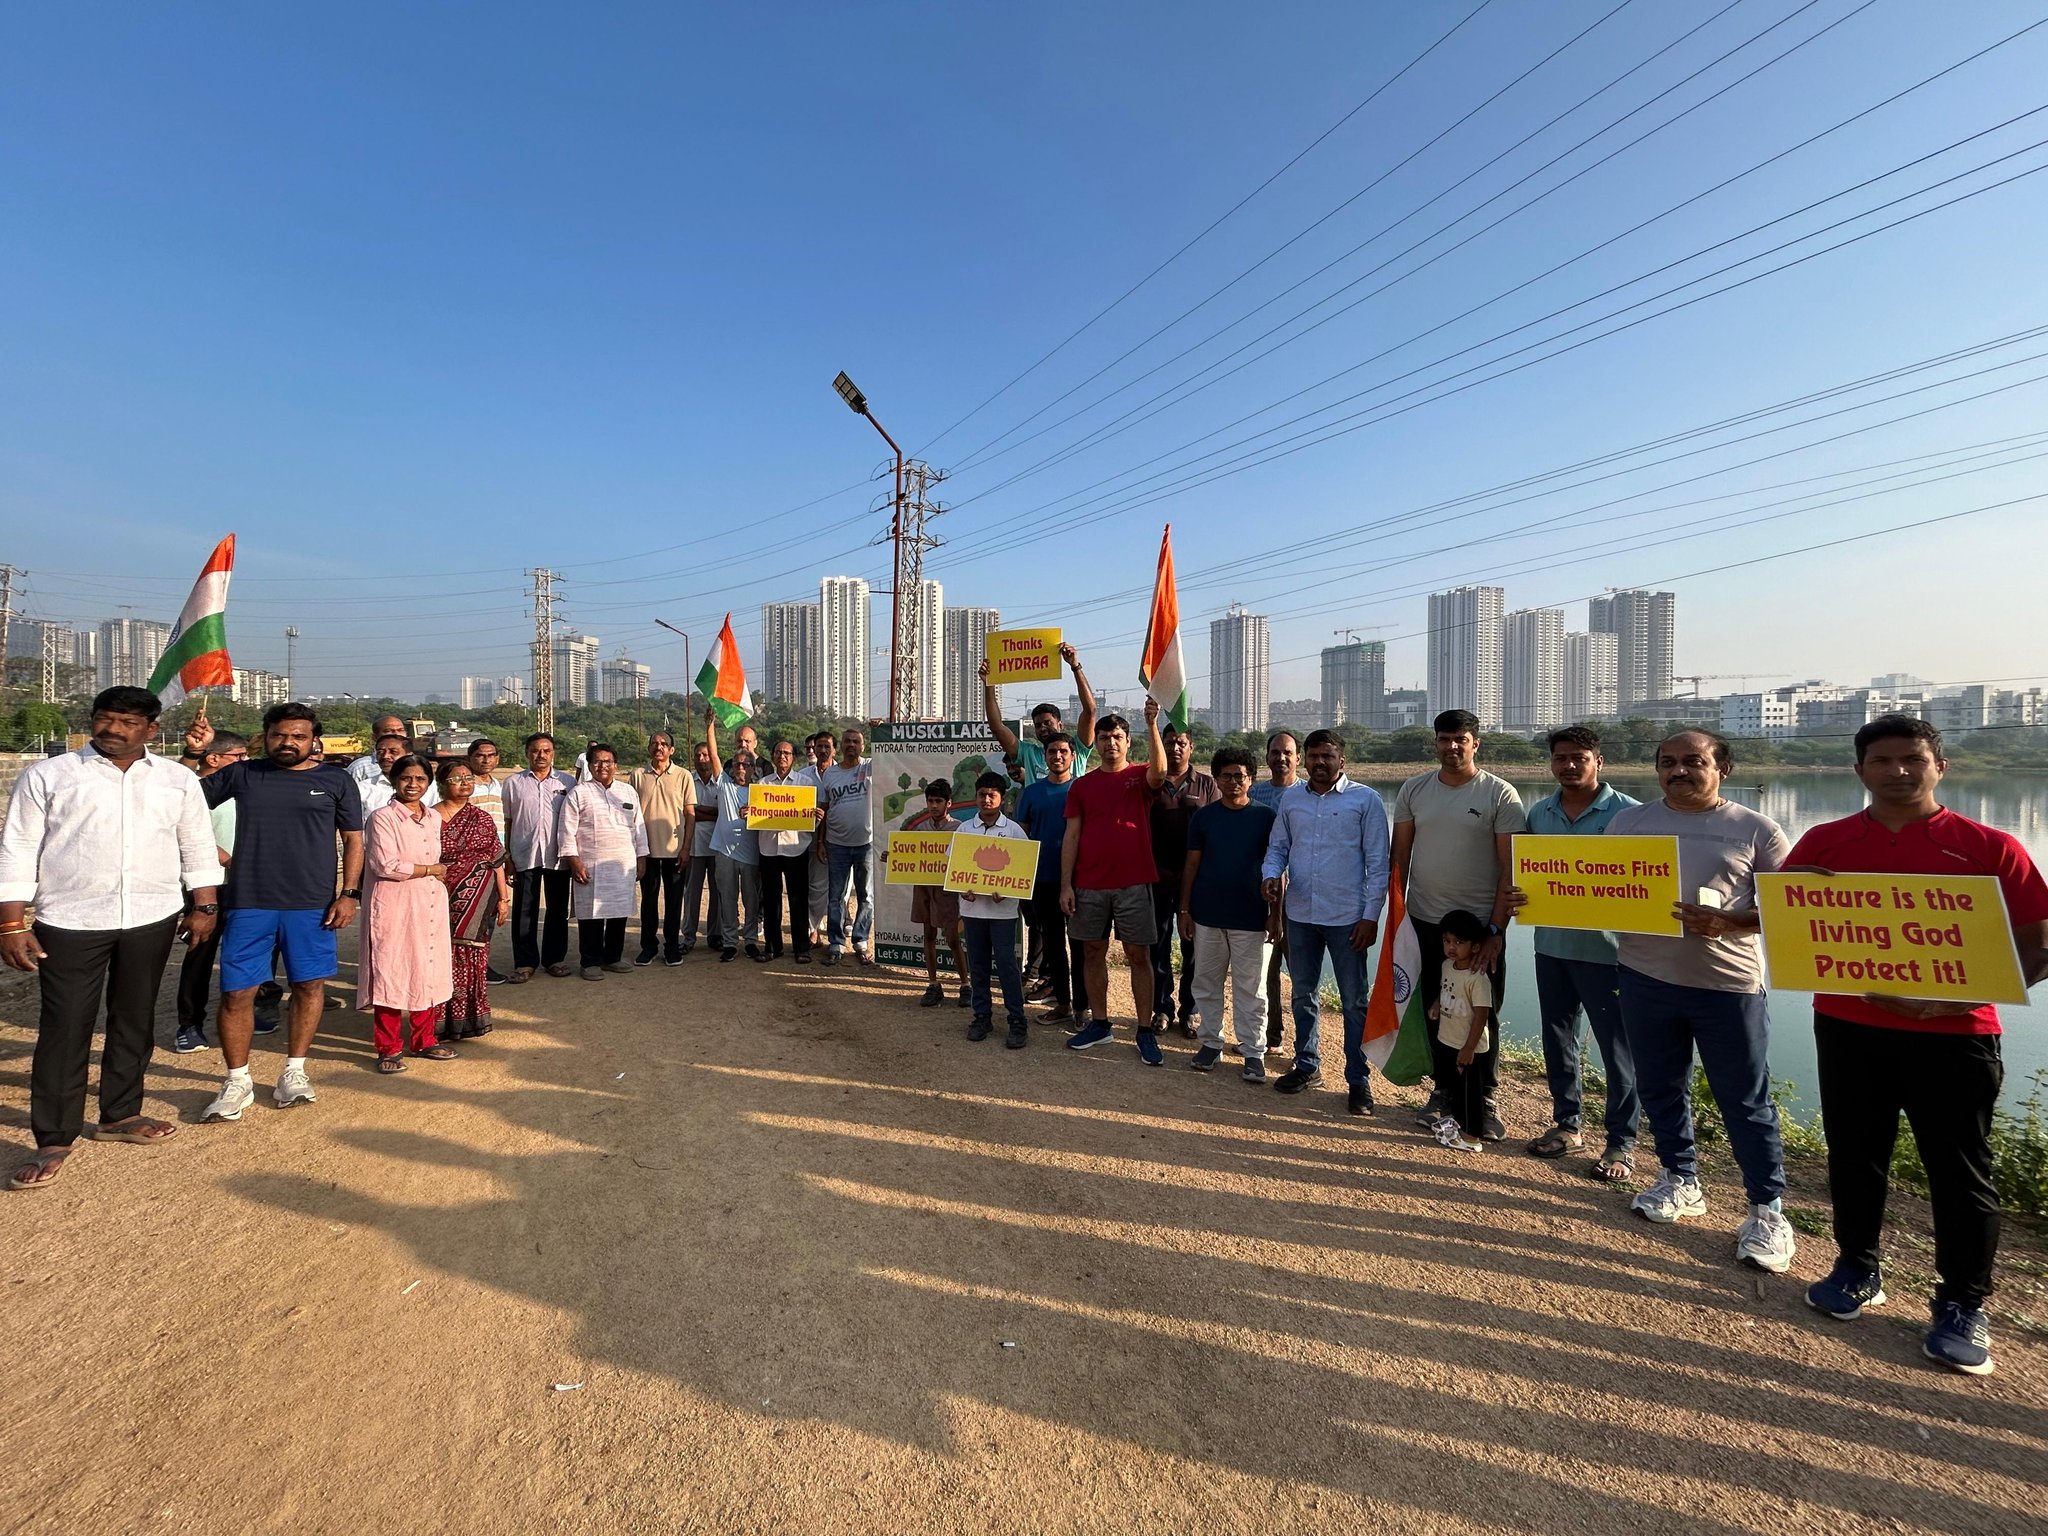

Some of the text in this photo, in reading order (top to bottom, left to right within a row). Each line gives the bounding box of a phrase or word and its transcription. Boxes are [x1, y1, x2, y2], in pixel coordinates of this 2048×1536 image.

[1002, 637, 1043, 652] Thanks
[998, 655, 1048, 673] HYDRAA
[892, 723, 993, 739] MUSKI LAKE
[874, 744, 903, 753] HYDRAA
[905, 743, 916, 752] for
[918, 743, 955, 754] Protecting
[956, 743, 987, 754] People's
[763, 792, 795, 803] Thanks
[831, 782, 867, 799] NASA
[750, 806, 814, 819] Ranganath Sir
[892, 840, 916, 854] Save
[891, 859, 915, 873] Save
[1520, 858, 1670, 877] Health Comes First
[950, 871, 1031, 890] SAVE TEMPLES
[1547, 881, 1649, 899] Then wealth
[1784, 885, 1974, 912] Nature is the
[875, 931, 900, 942] HYDRAA
[902, 933, 911, 943] for
[1809, 919, 1964, 950] living God
[877, 948, 899, 960] Let's
[901, 950, 913, 961] All
[1814, 954, 1968, 985] Protect it!
